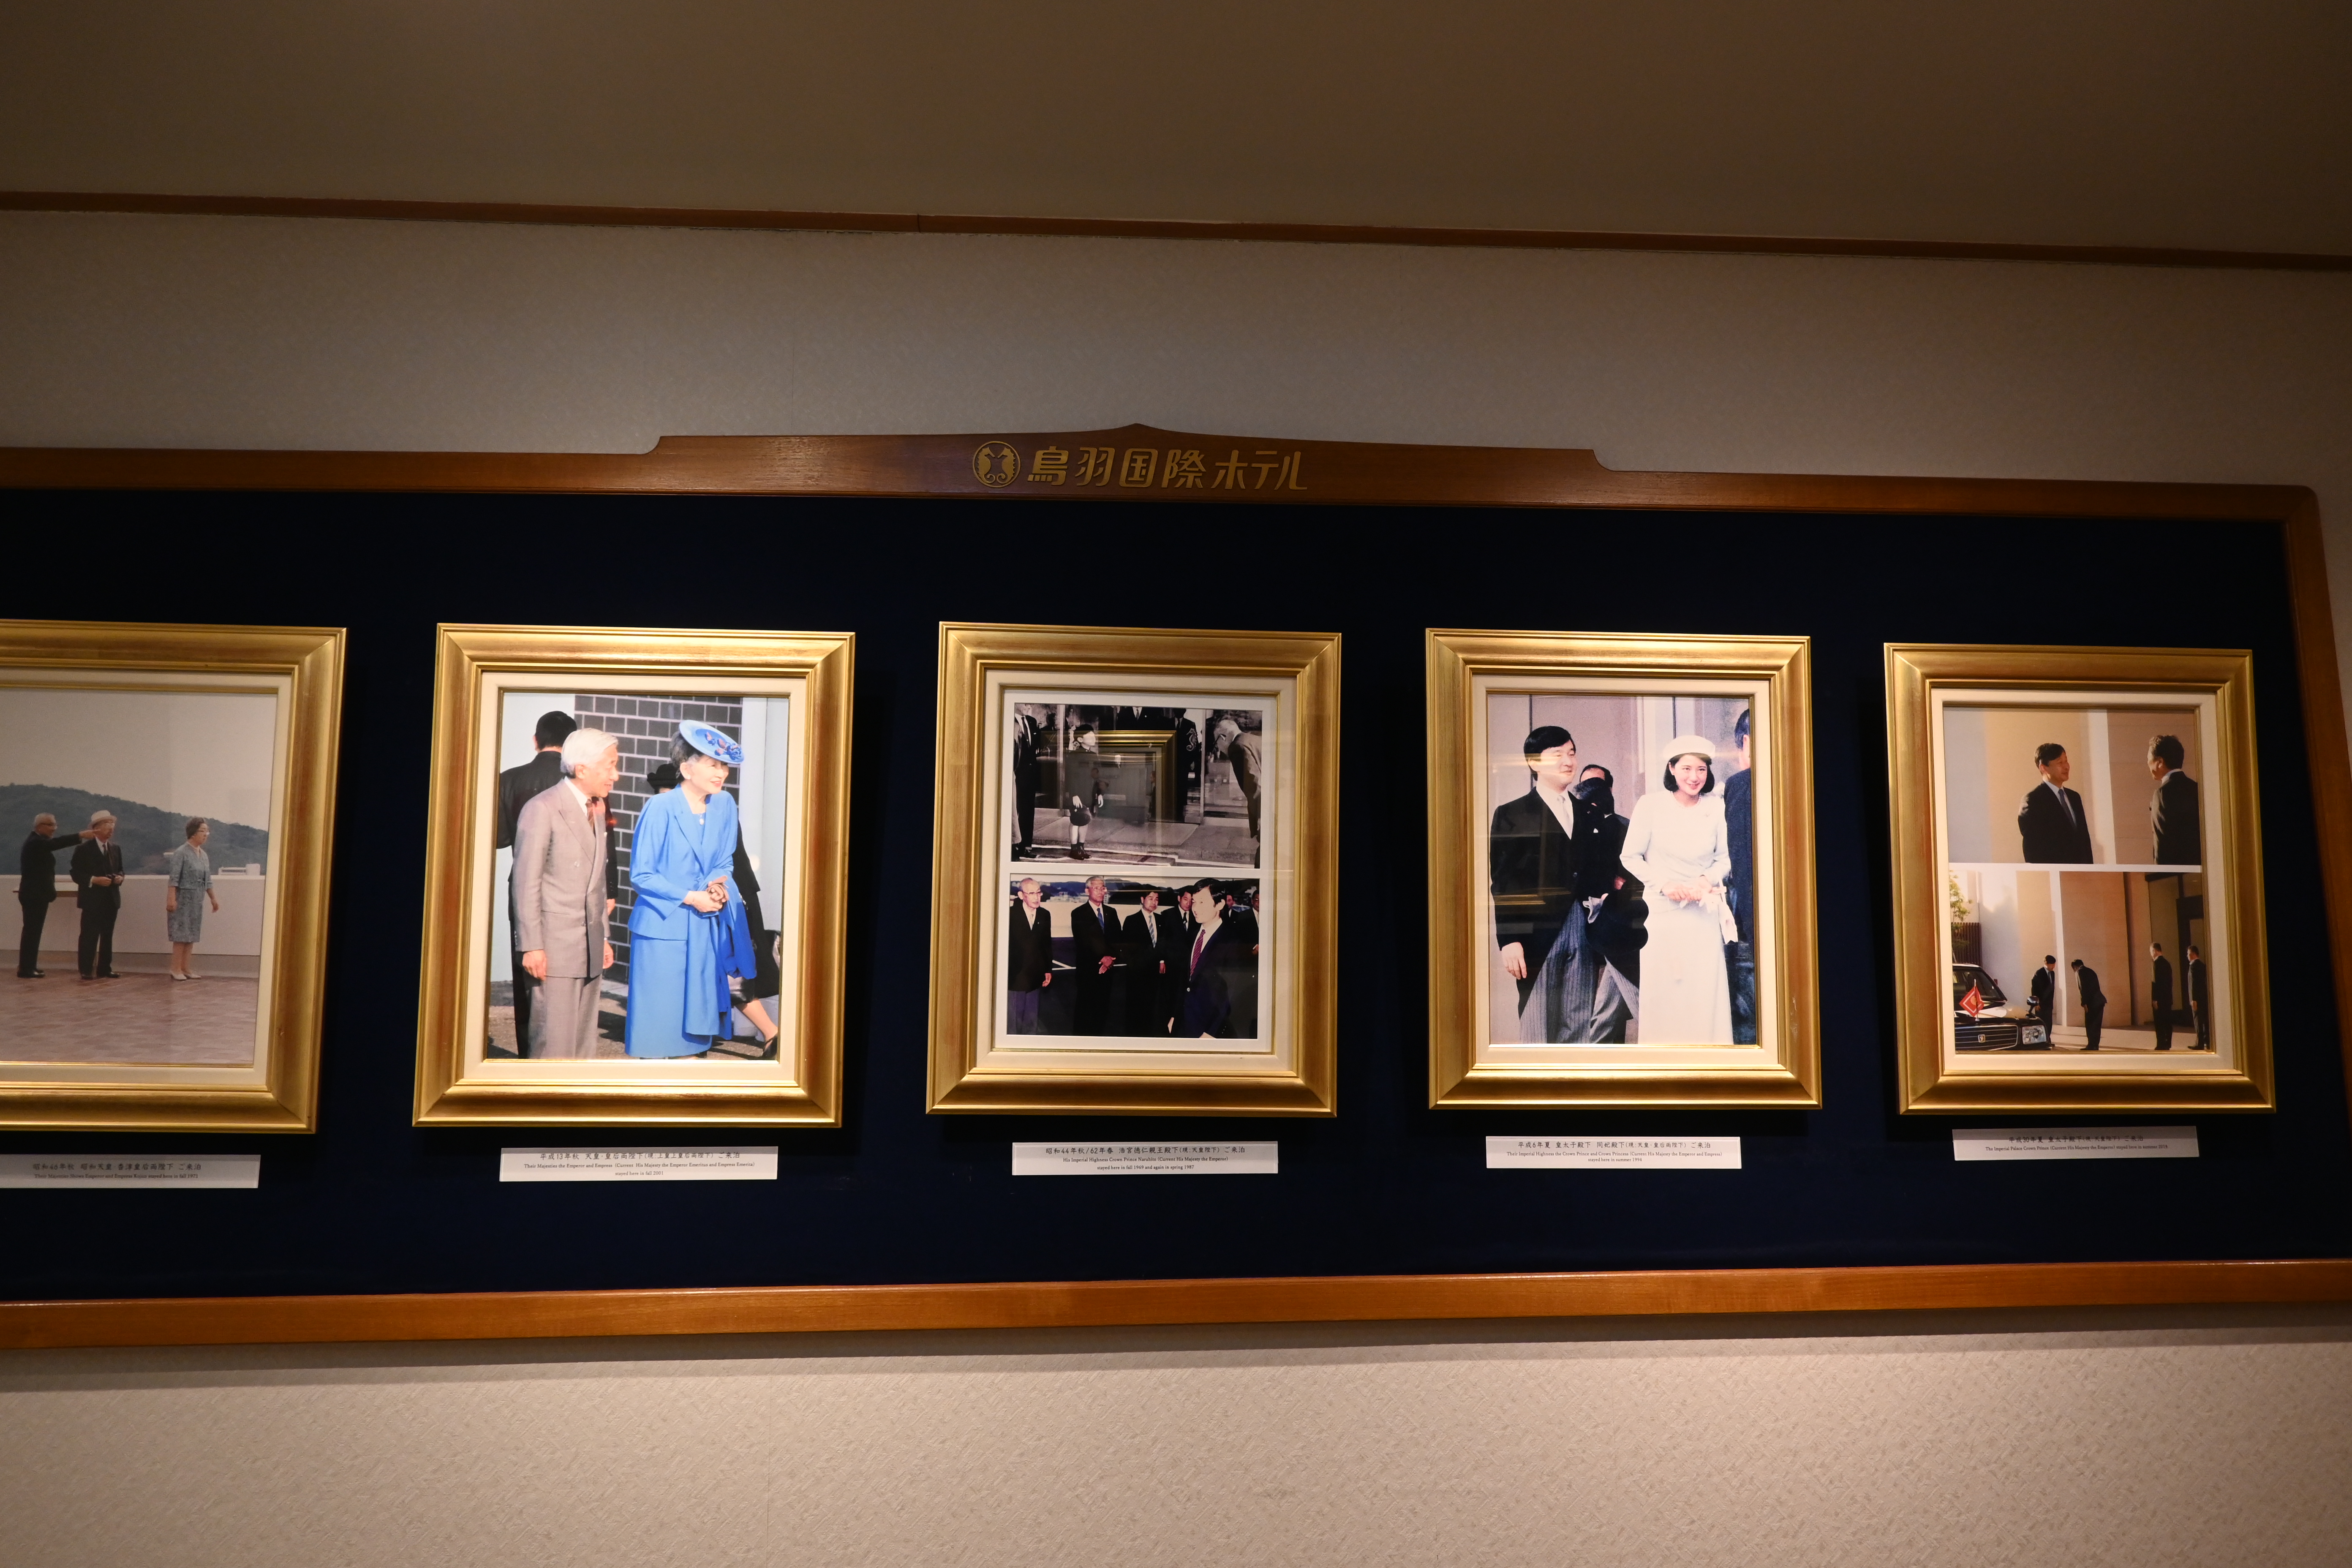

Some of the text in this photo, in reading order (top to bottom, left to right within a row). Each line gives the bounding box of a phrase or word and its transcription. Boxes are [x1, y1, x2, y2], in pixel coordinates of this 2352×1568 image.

[1027, 446, 1307, 490] 鳥羽国際ホテル
